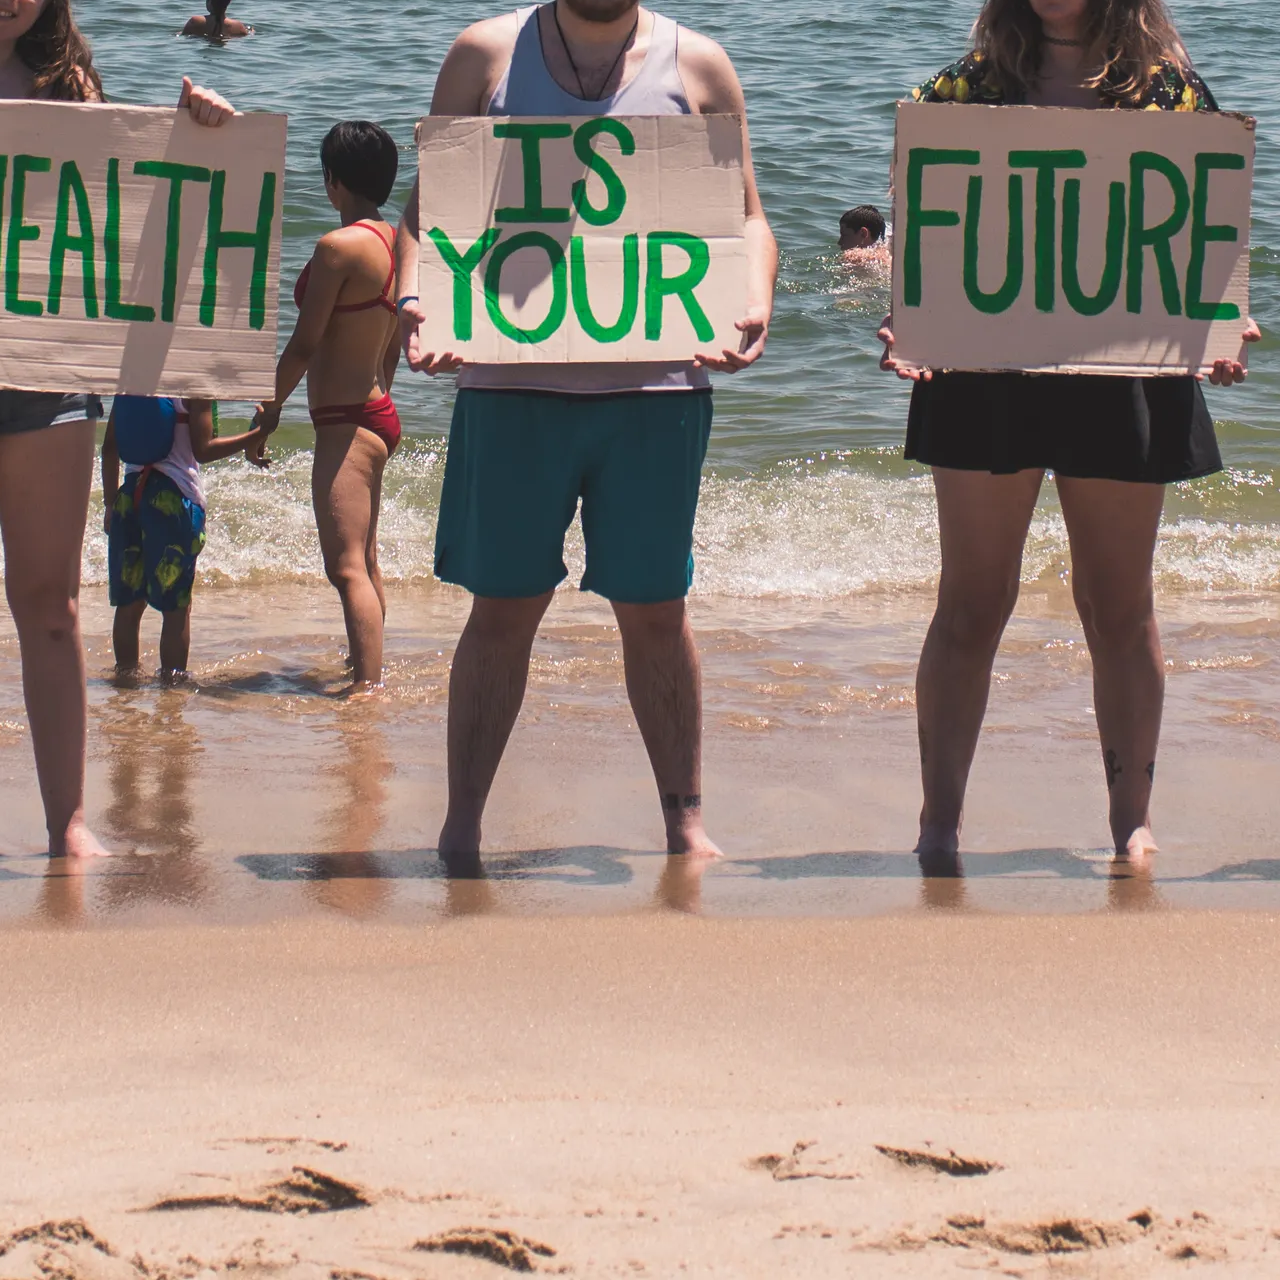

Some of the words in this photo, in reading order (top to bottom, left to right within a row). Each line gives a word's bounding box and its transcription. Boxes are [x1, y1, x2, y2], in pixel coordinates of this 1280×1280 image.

[495, 118, 635, 226] IS
[427, 228, 715, 345] YOUR
[905, 150, 1246, 320] FUTURE
